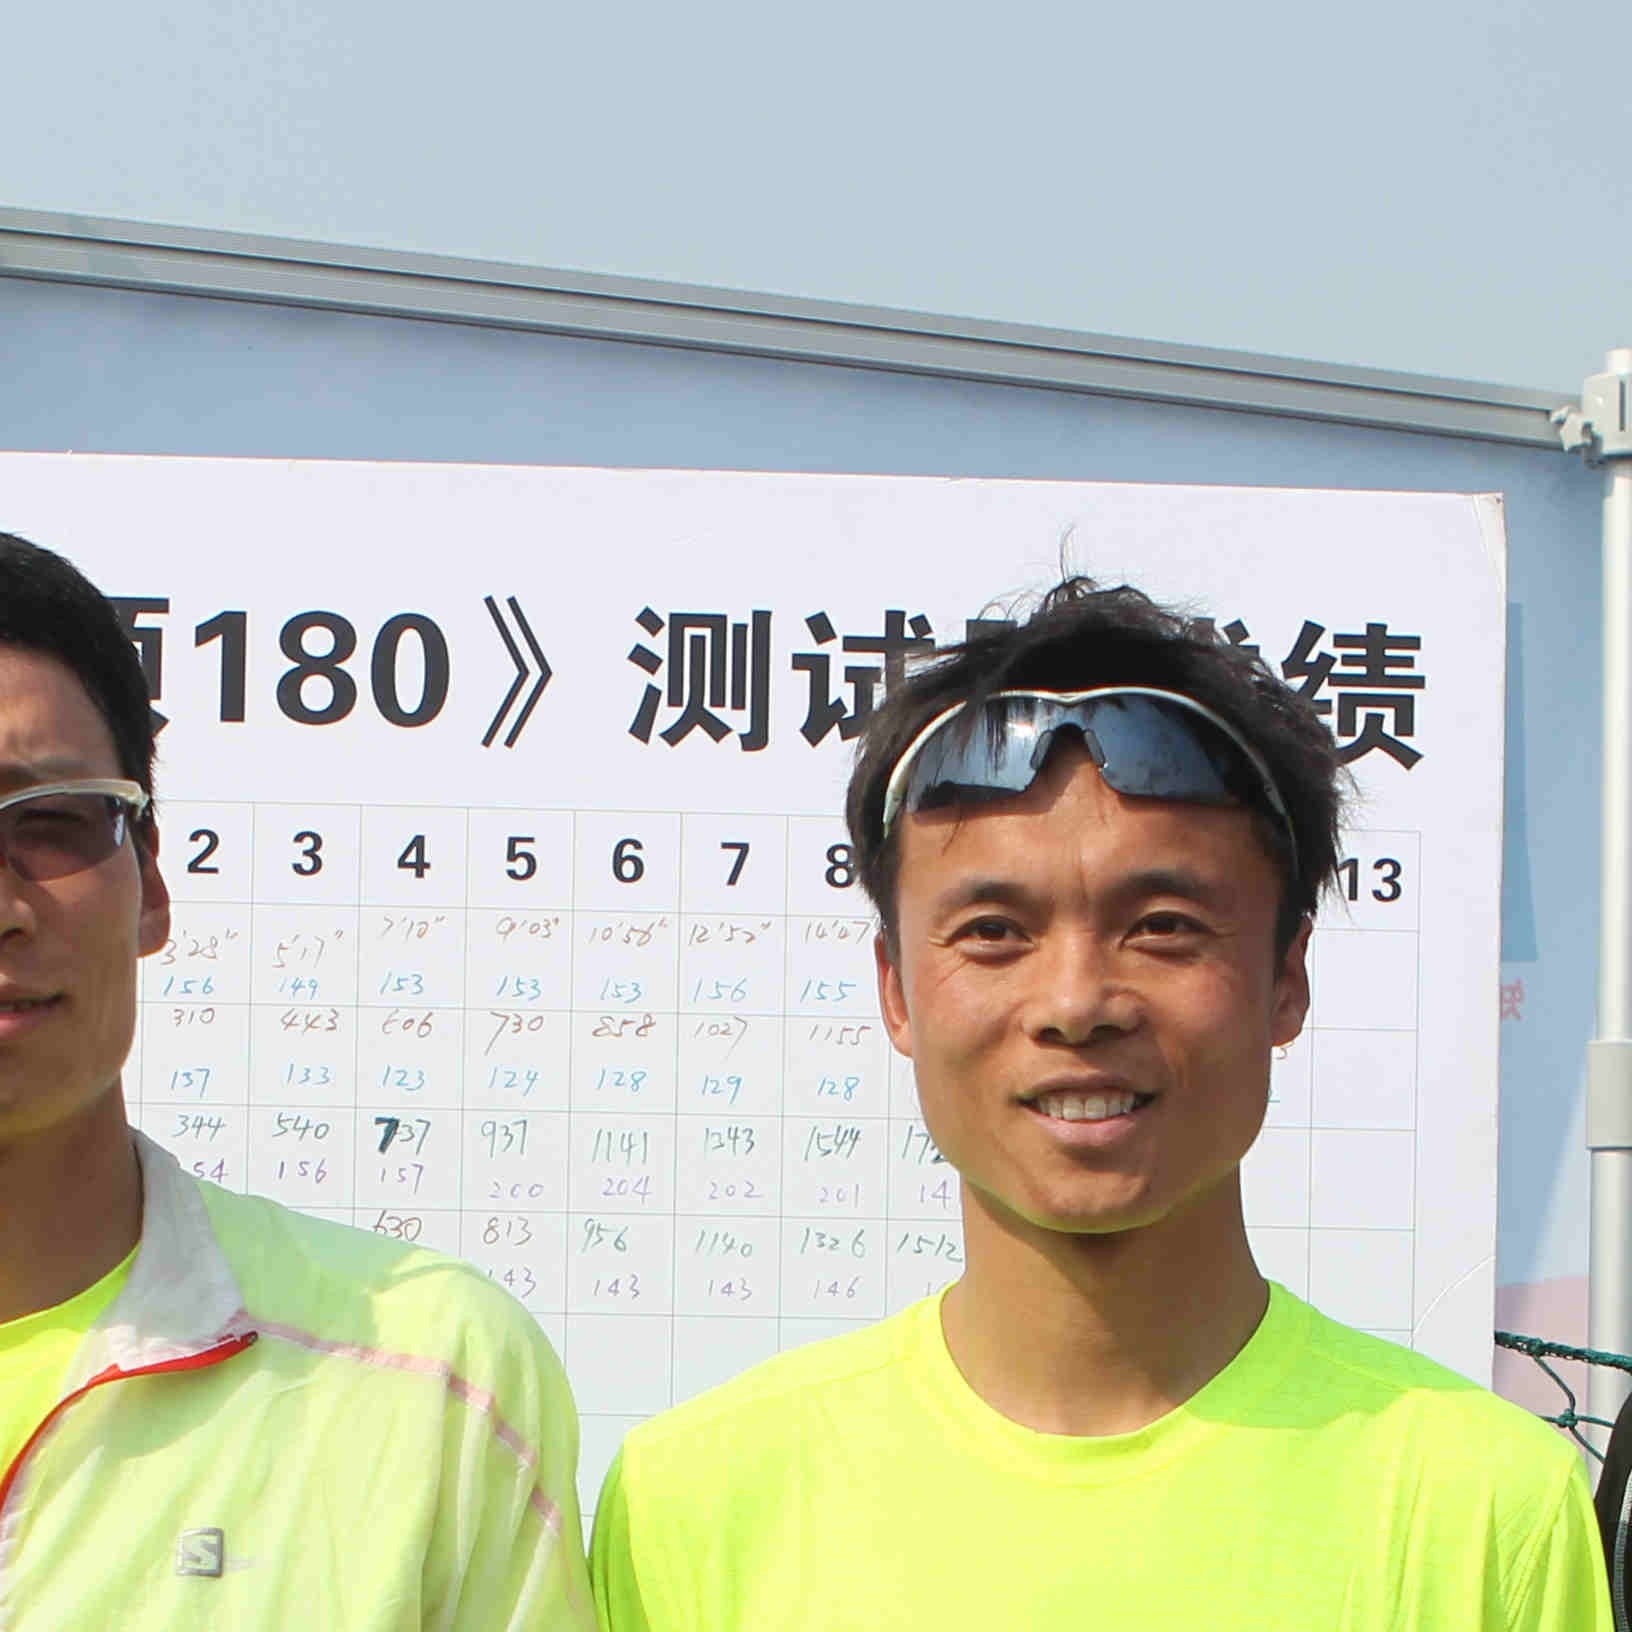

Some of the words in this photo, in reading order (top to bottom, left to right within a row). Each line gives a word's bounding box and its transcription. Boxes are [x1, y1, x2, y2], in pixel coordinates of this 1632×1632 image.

[187, 830, 220, 874] 2
[292, 832, 323, 875] 3
[396, 835, 430, 879] 4
[506, 836, 538, 880] 5
[612, 839, 644, 882] 6
[720, 842, 751, 885] 7
[824, 844, 855, 887] 8
[375, 1116, 431, 1156] 737
[481, 1119, 528, 1158] 937
